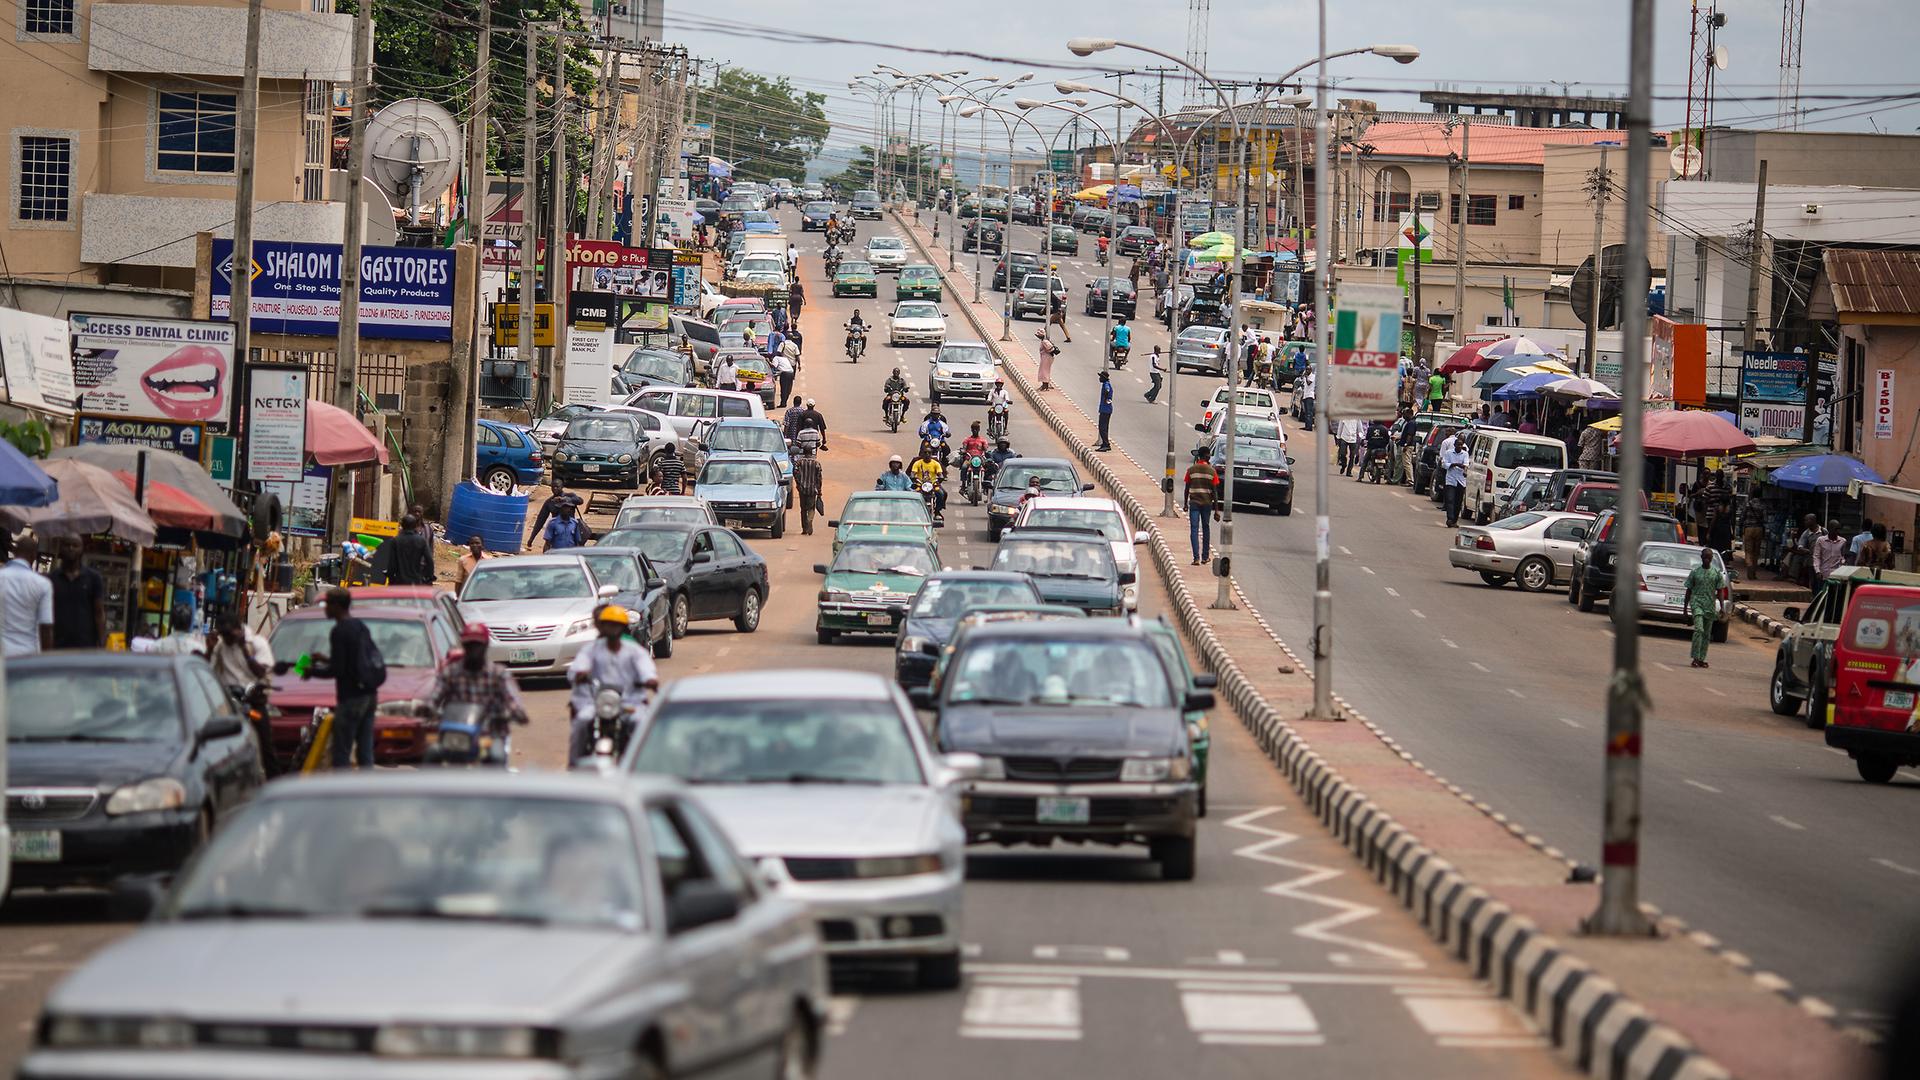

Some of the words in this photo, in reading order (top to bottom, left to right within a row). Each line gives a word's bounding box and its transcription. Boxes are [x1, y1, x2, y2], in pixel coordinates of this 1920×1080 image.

[483, 248, 521, 261] ATM
[630, 253, 646, 263] Plus
[266, 251, 331, 280] SHALOM
[274, 283, 292, 291] One
[296, 284, 317, 294] Stop
[320, 285, 341, 294] Shop
[364, 287, 398, 298] Quality
[401, 288, 440, 298] Products
[253, 303, 281, 315] FURNITURE
[287, 304, 318, 316] HOUSEHOLD
[380, 309, 409, 320] MATERIALS
[415, 311, 451, 321] FURNISHINGS
[576, 307, 607, 318] FCMB
[82, 323, 131, 337] ACCESS
[136, 326, 183, 339] DENTAL
[187, 330, 230, 342] CLINIC
[1347, 352, 1387, 367] APC
[1879, 372, 1891, 423] BISBOL
